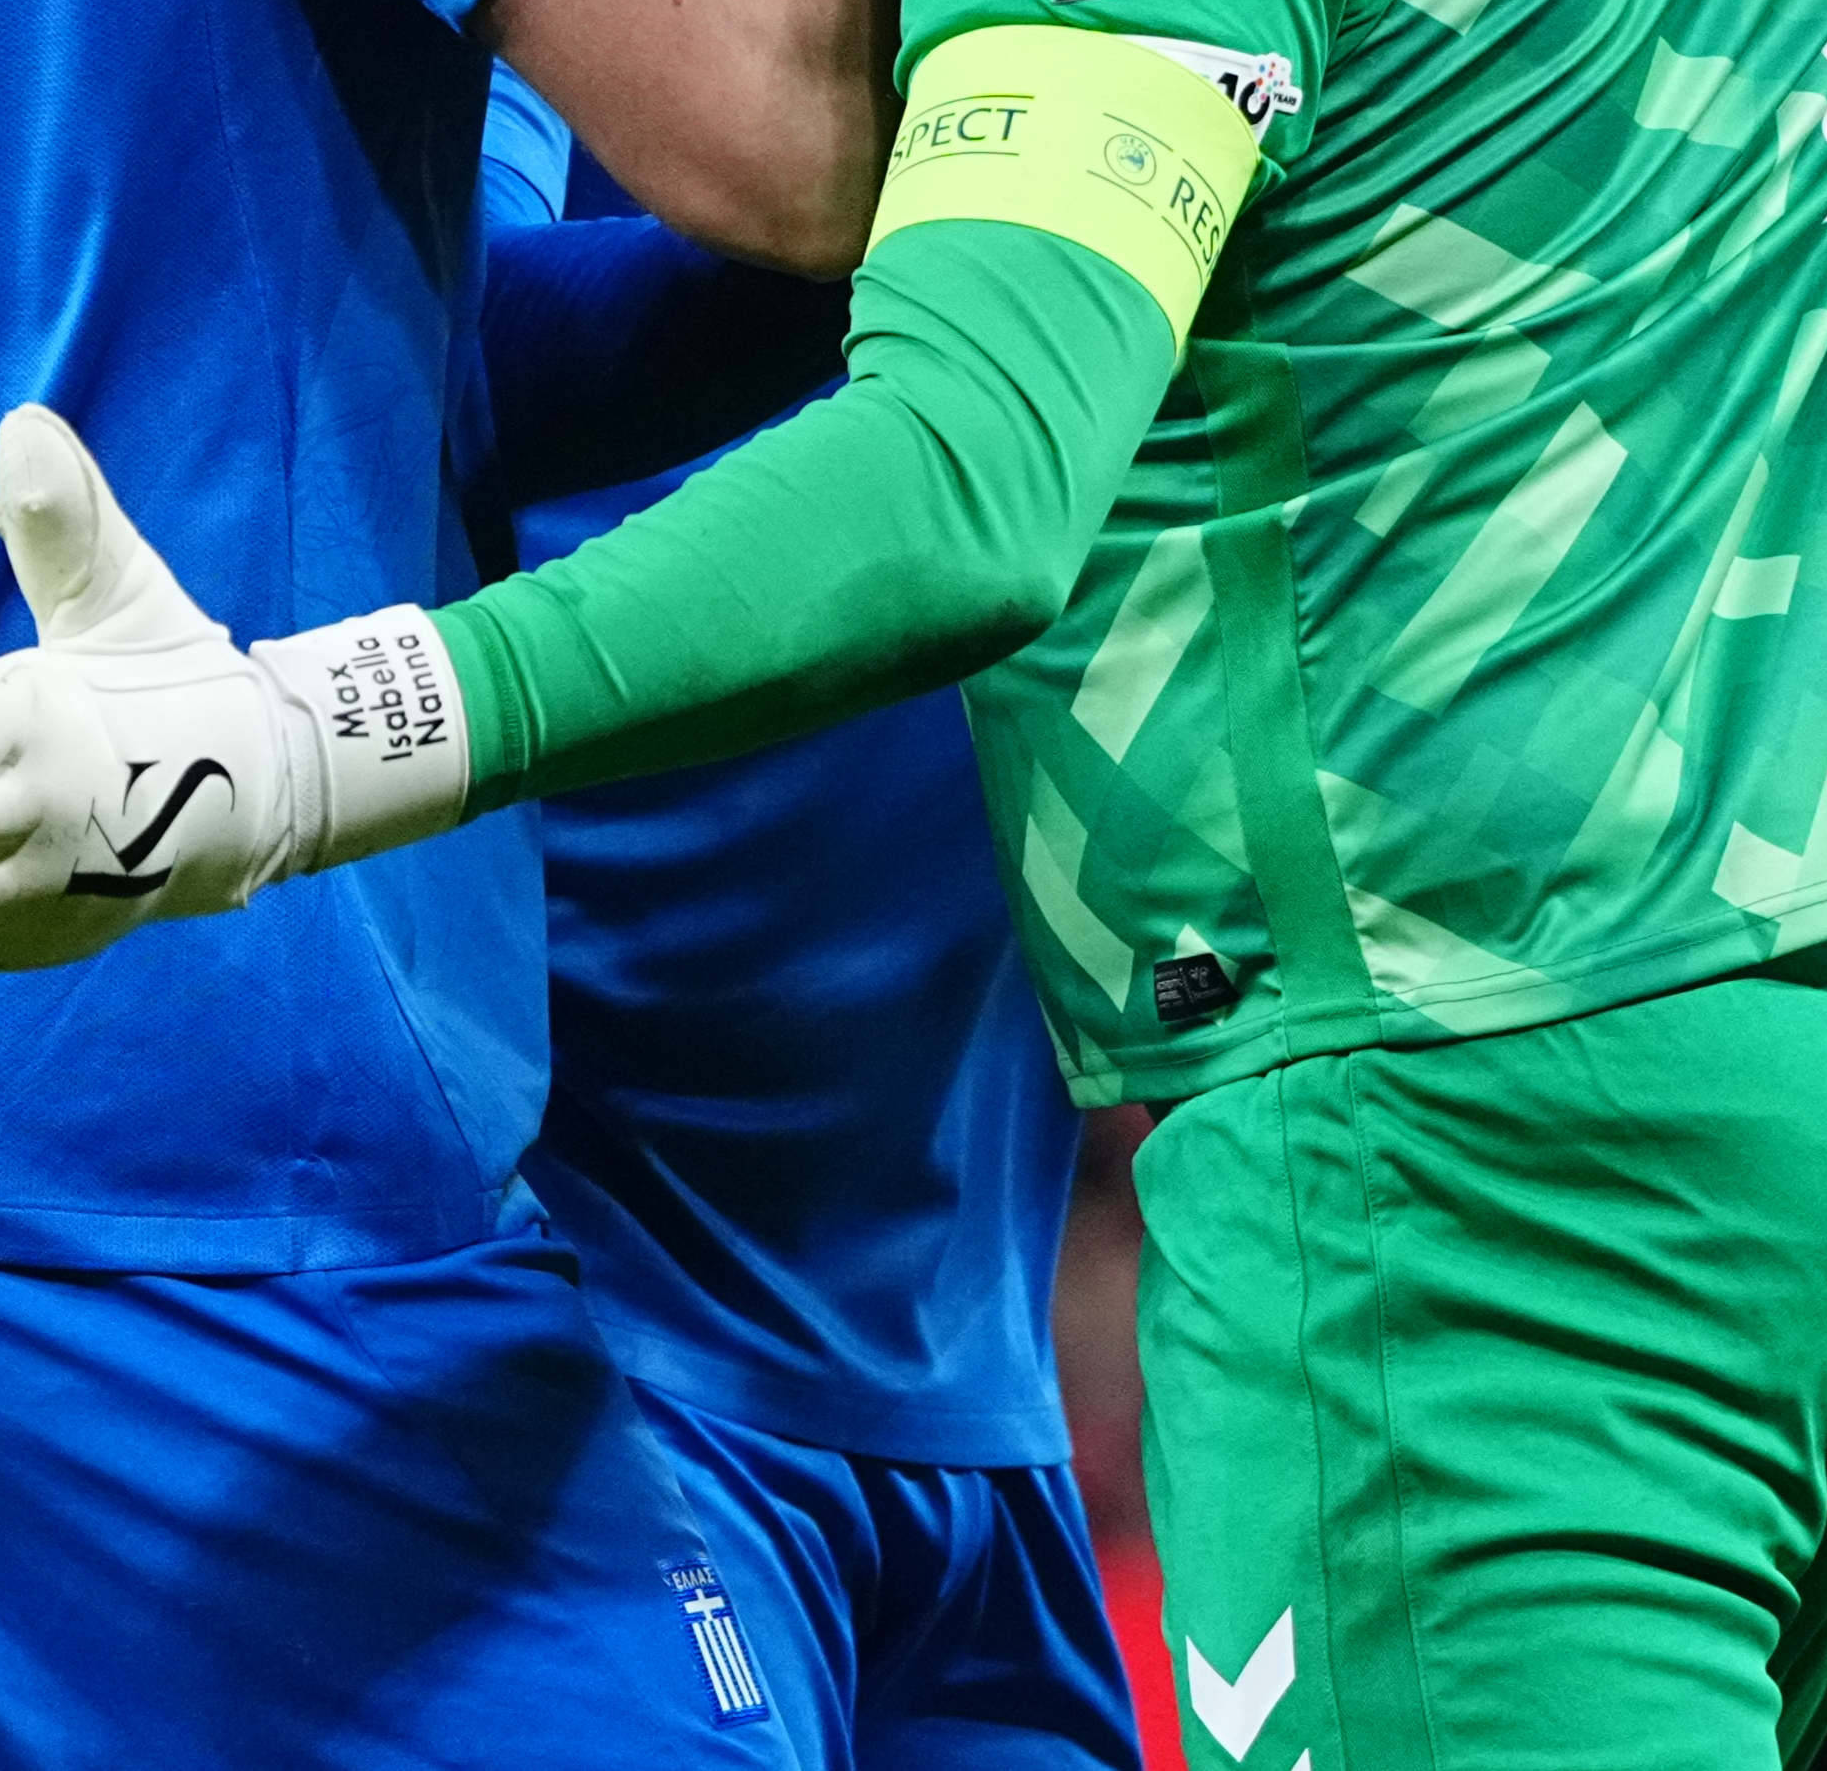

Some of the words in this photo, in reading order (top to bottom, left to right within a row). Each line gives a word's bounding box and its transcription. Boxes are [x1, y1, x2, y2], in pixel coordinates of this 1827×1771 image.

[326, 663, 370, 737] Max
[351, 637, 413, 761] Isabella
[396, 634, 448, 747] Nanna
